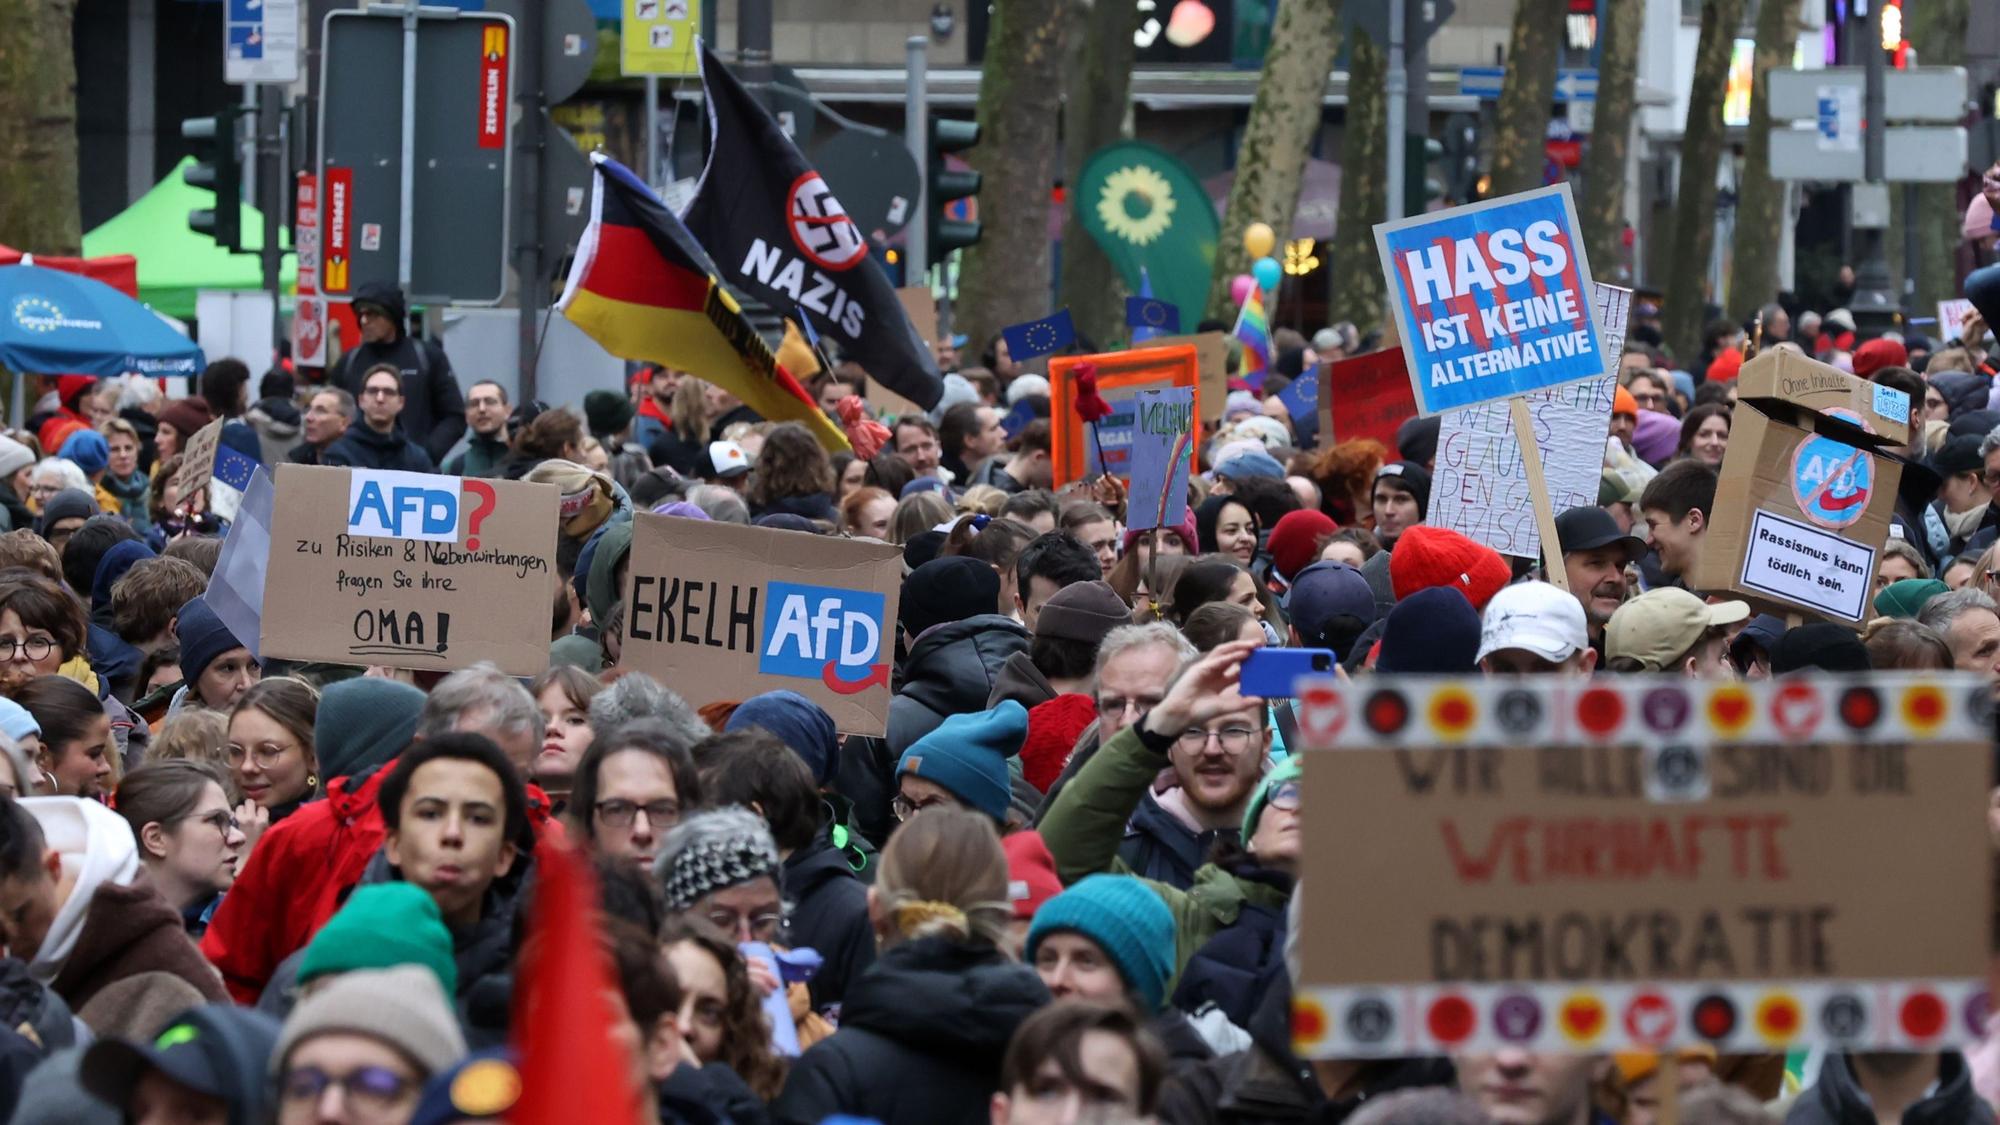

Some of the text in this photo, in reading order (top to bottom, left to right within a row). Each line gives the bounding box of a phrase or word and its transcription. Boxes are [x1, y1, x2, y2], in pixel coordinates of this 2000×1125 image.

[485, 68, 499, 135] ZEPPELIN
[740, 237, 865, 339] NAZIS
[1406, 219, 1567, 305] HASS
[1422, 313, 1469, 352] IST
[1480, 289, 1579, 339] KEINE
[1431, 329, 1592, 388] ALTERNATIVE
[1782, 372, 1846, 396] Ohne Inhalte
[1440, 468, 1596, 515] DEN GAZE
[296, 540, 322, 555] zu
[336, 534, 394, 558] Risiken
[404, 539, 416, 562] &
[1760, 528, 1864, 576] Rassismus kann
[1768, 556, 1845, 593] tödlich sein.
[336, 570, 457, 596] fragen Sie ihre
[1397, 743, 1502, 794] WIR
[1439, 812, 1792, 884] WEHRHAFTE
[1430, 905, 1836, 982] DEMOKRATIE
